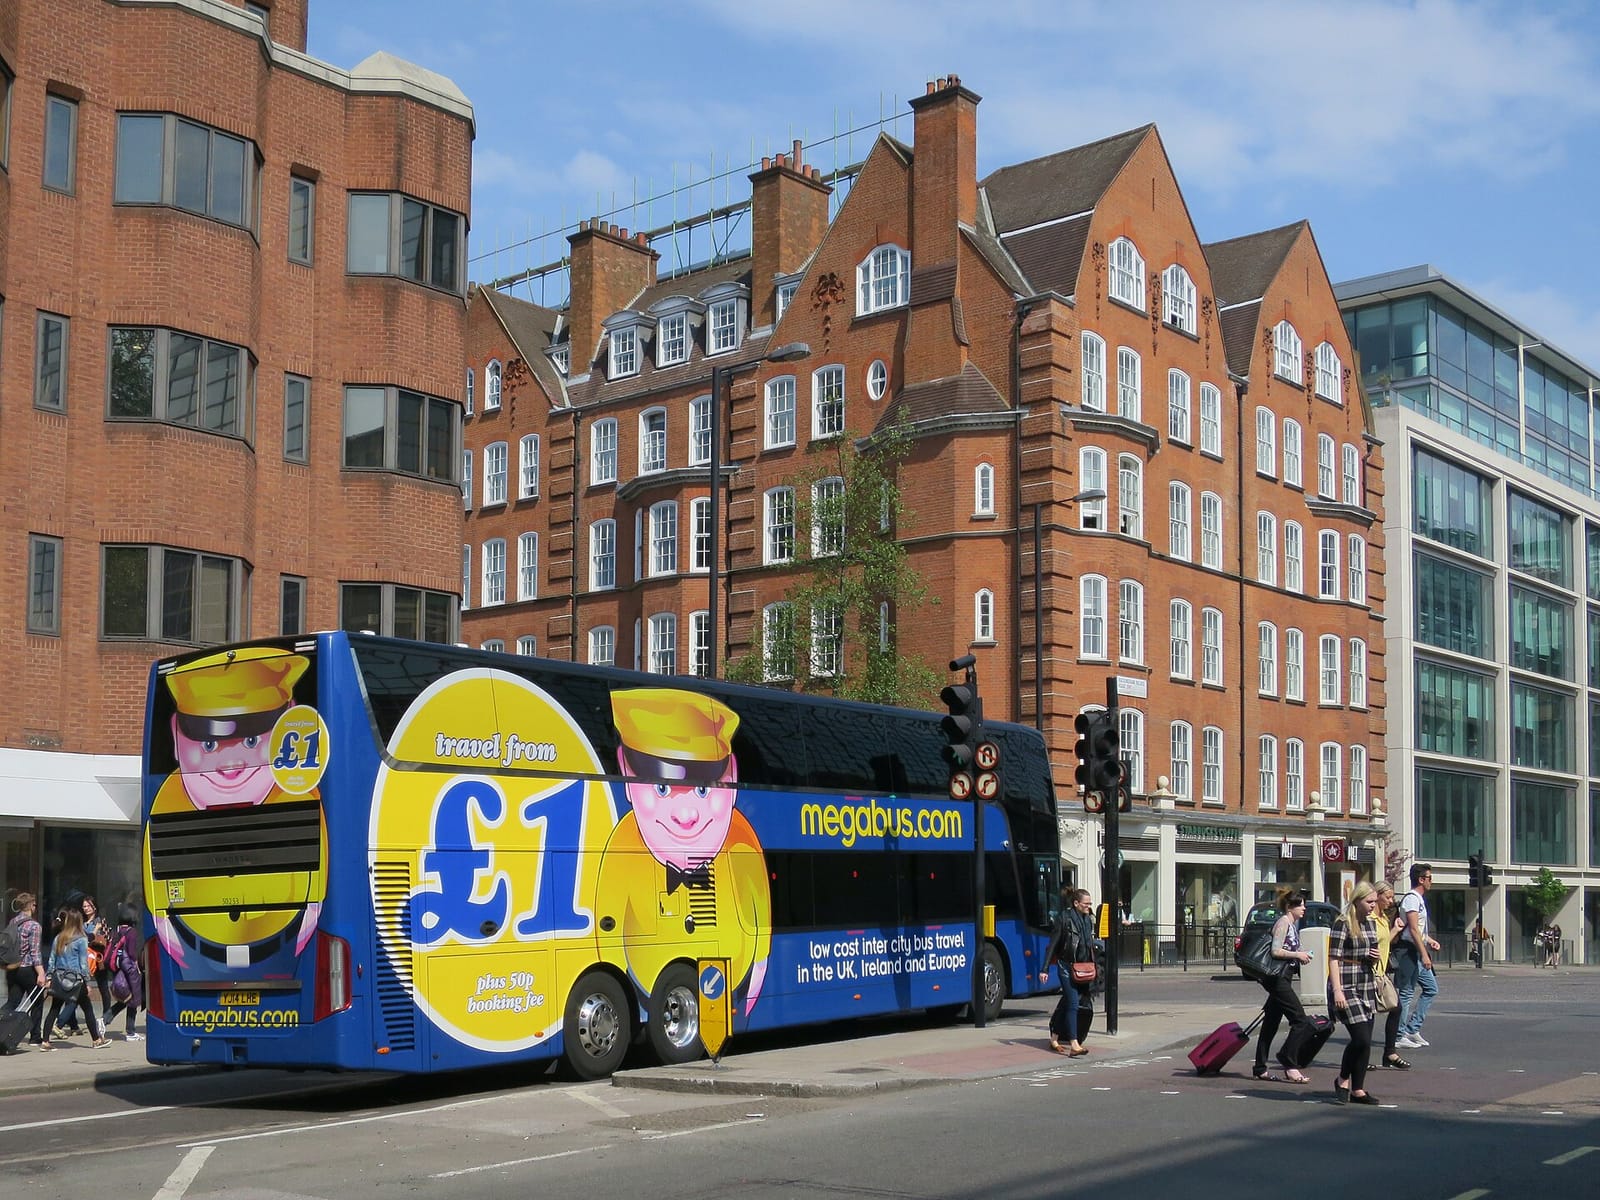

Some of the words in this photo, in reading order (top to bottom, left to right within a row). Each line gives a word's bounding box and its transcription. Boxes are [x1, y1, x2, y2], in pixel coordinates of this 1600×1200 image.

[271, 730, 320, 770] £1
[435, 732, 501, 759] travel
[501, 734, 557, 767] from
[801, 799, 963, 848] megabus.com
[406, 778, 592, 947] £1
[809, 940, 831, 960] low
[833, 937, 860, 958] cost
[862, 937, 889, 956] inter
[890, 935, 911, 957] city
[914, 934, 934, 951] bus
[936, 931, 965, 950] travel
[797, 964, 809, 983] in
[812, 962, 834, 982] the
[837, 960, 858, 980] UK,
[861, 957, 902, 978] Ireland
[904, 954, 926, 973] and
[928, 953, 966, 972] Europe
[241, 991, 258, 1004] LHE
[475, 973, 506, 996] plus
[508, 971, 534, 991] 50p
[467, 994, 523, 1014] booking
[522, 991, 545, 1012] fee
[179, 1006, 299, 1033] megabus.com
